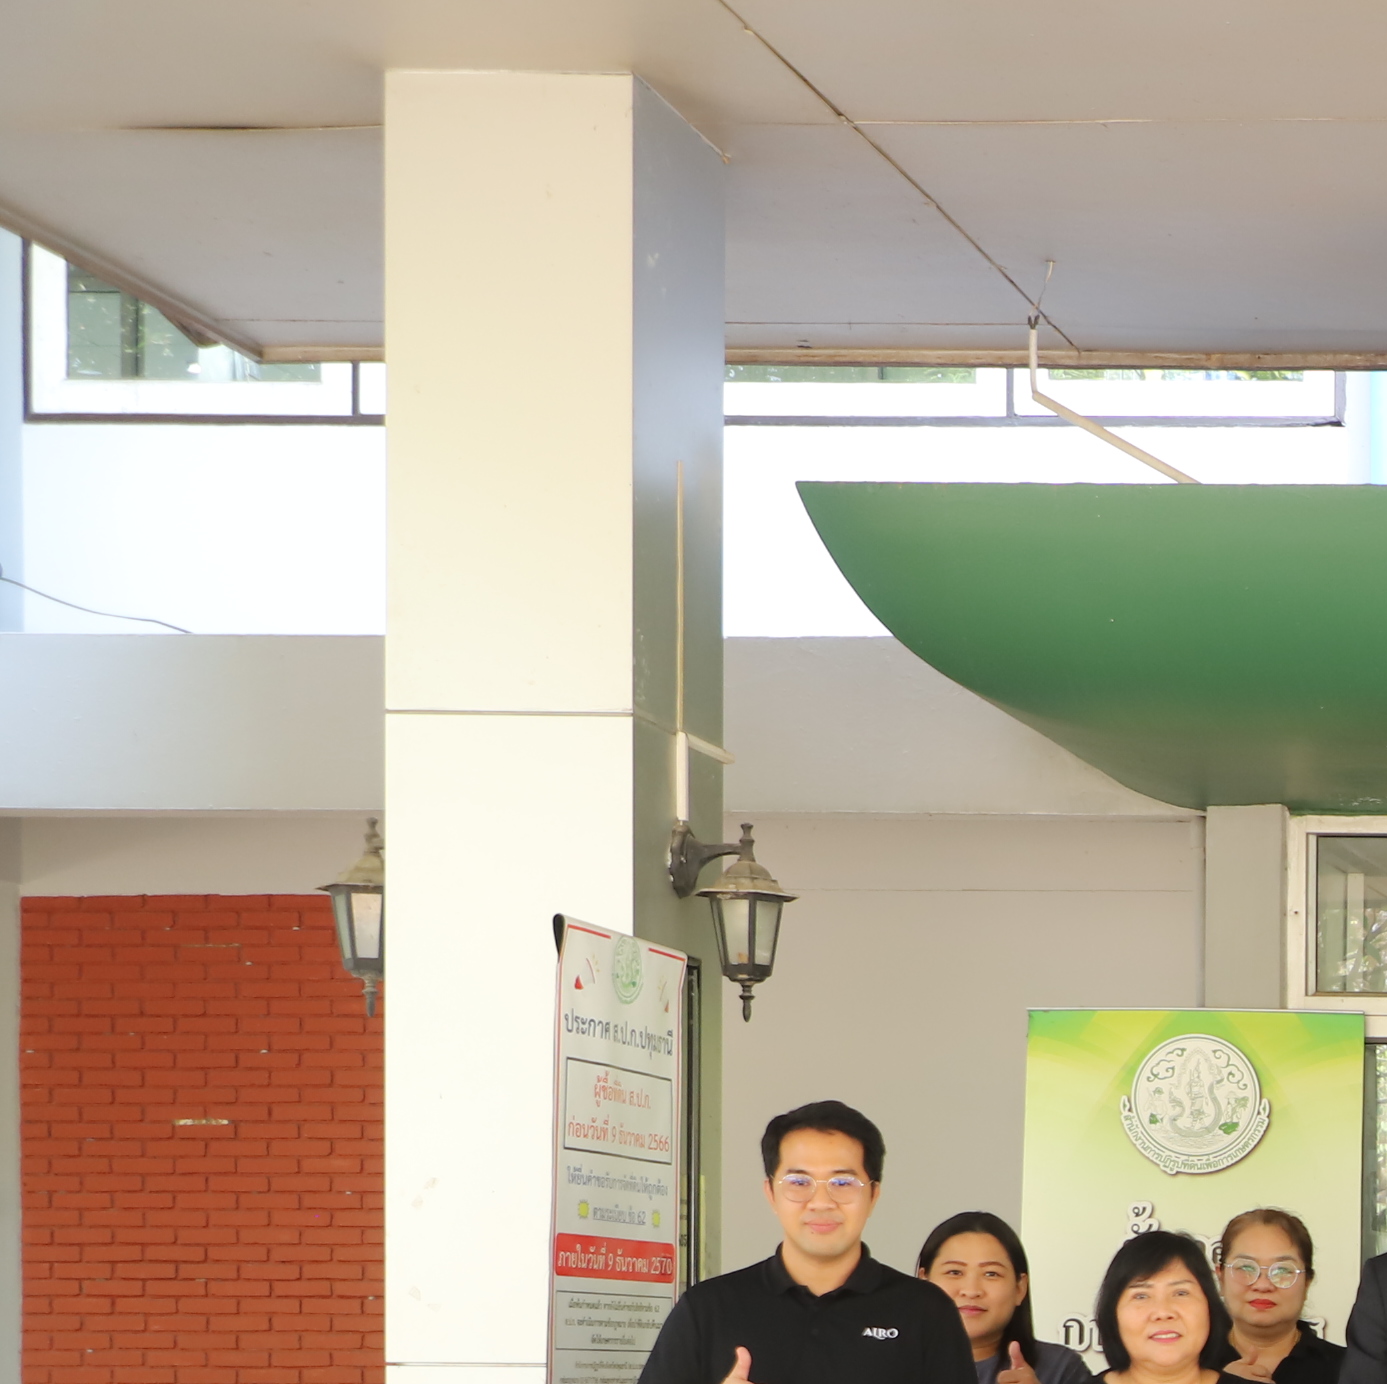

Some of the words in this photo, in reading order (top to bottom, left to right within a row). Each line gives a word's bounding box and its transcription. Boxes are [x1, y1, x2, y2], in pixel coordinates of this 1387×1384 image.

[564, 1008, 611, 1041] ประกาศ
[568, 1114, 610, 1142] ก่อนวันที่
[611, 1126, 617, 1143] 9
[648, 1133, 670, 1152] 2566
[558, 1242, 606, 1270] ภายในวันที่
[608, 1253, 614, 1271] 9
[616, 1248, 648, 1274] ธันวาคม
[650, 1256, 672, 1275] 2570
[861, 1327, 899, 1340] ALRO
